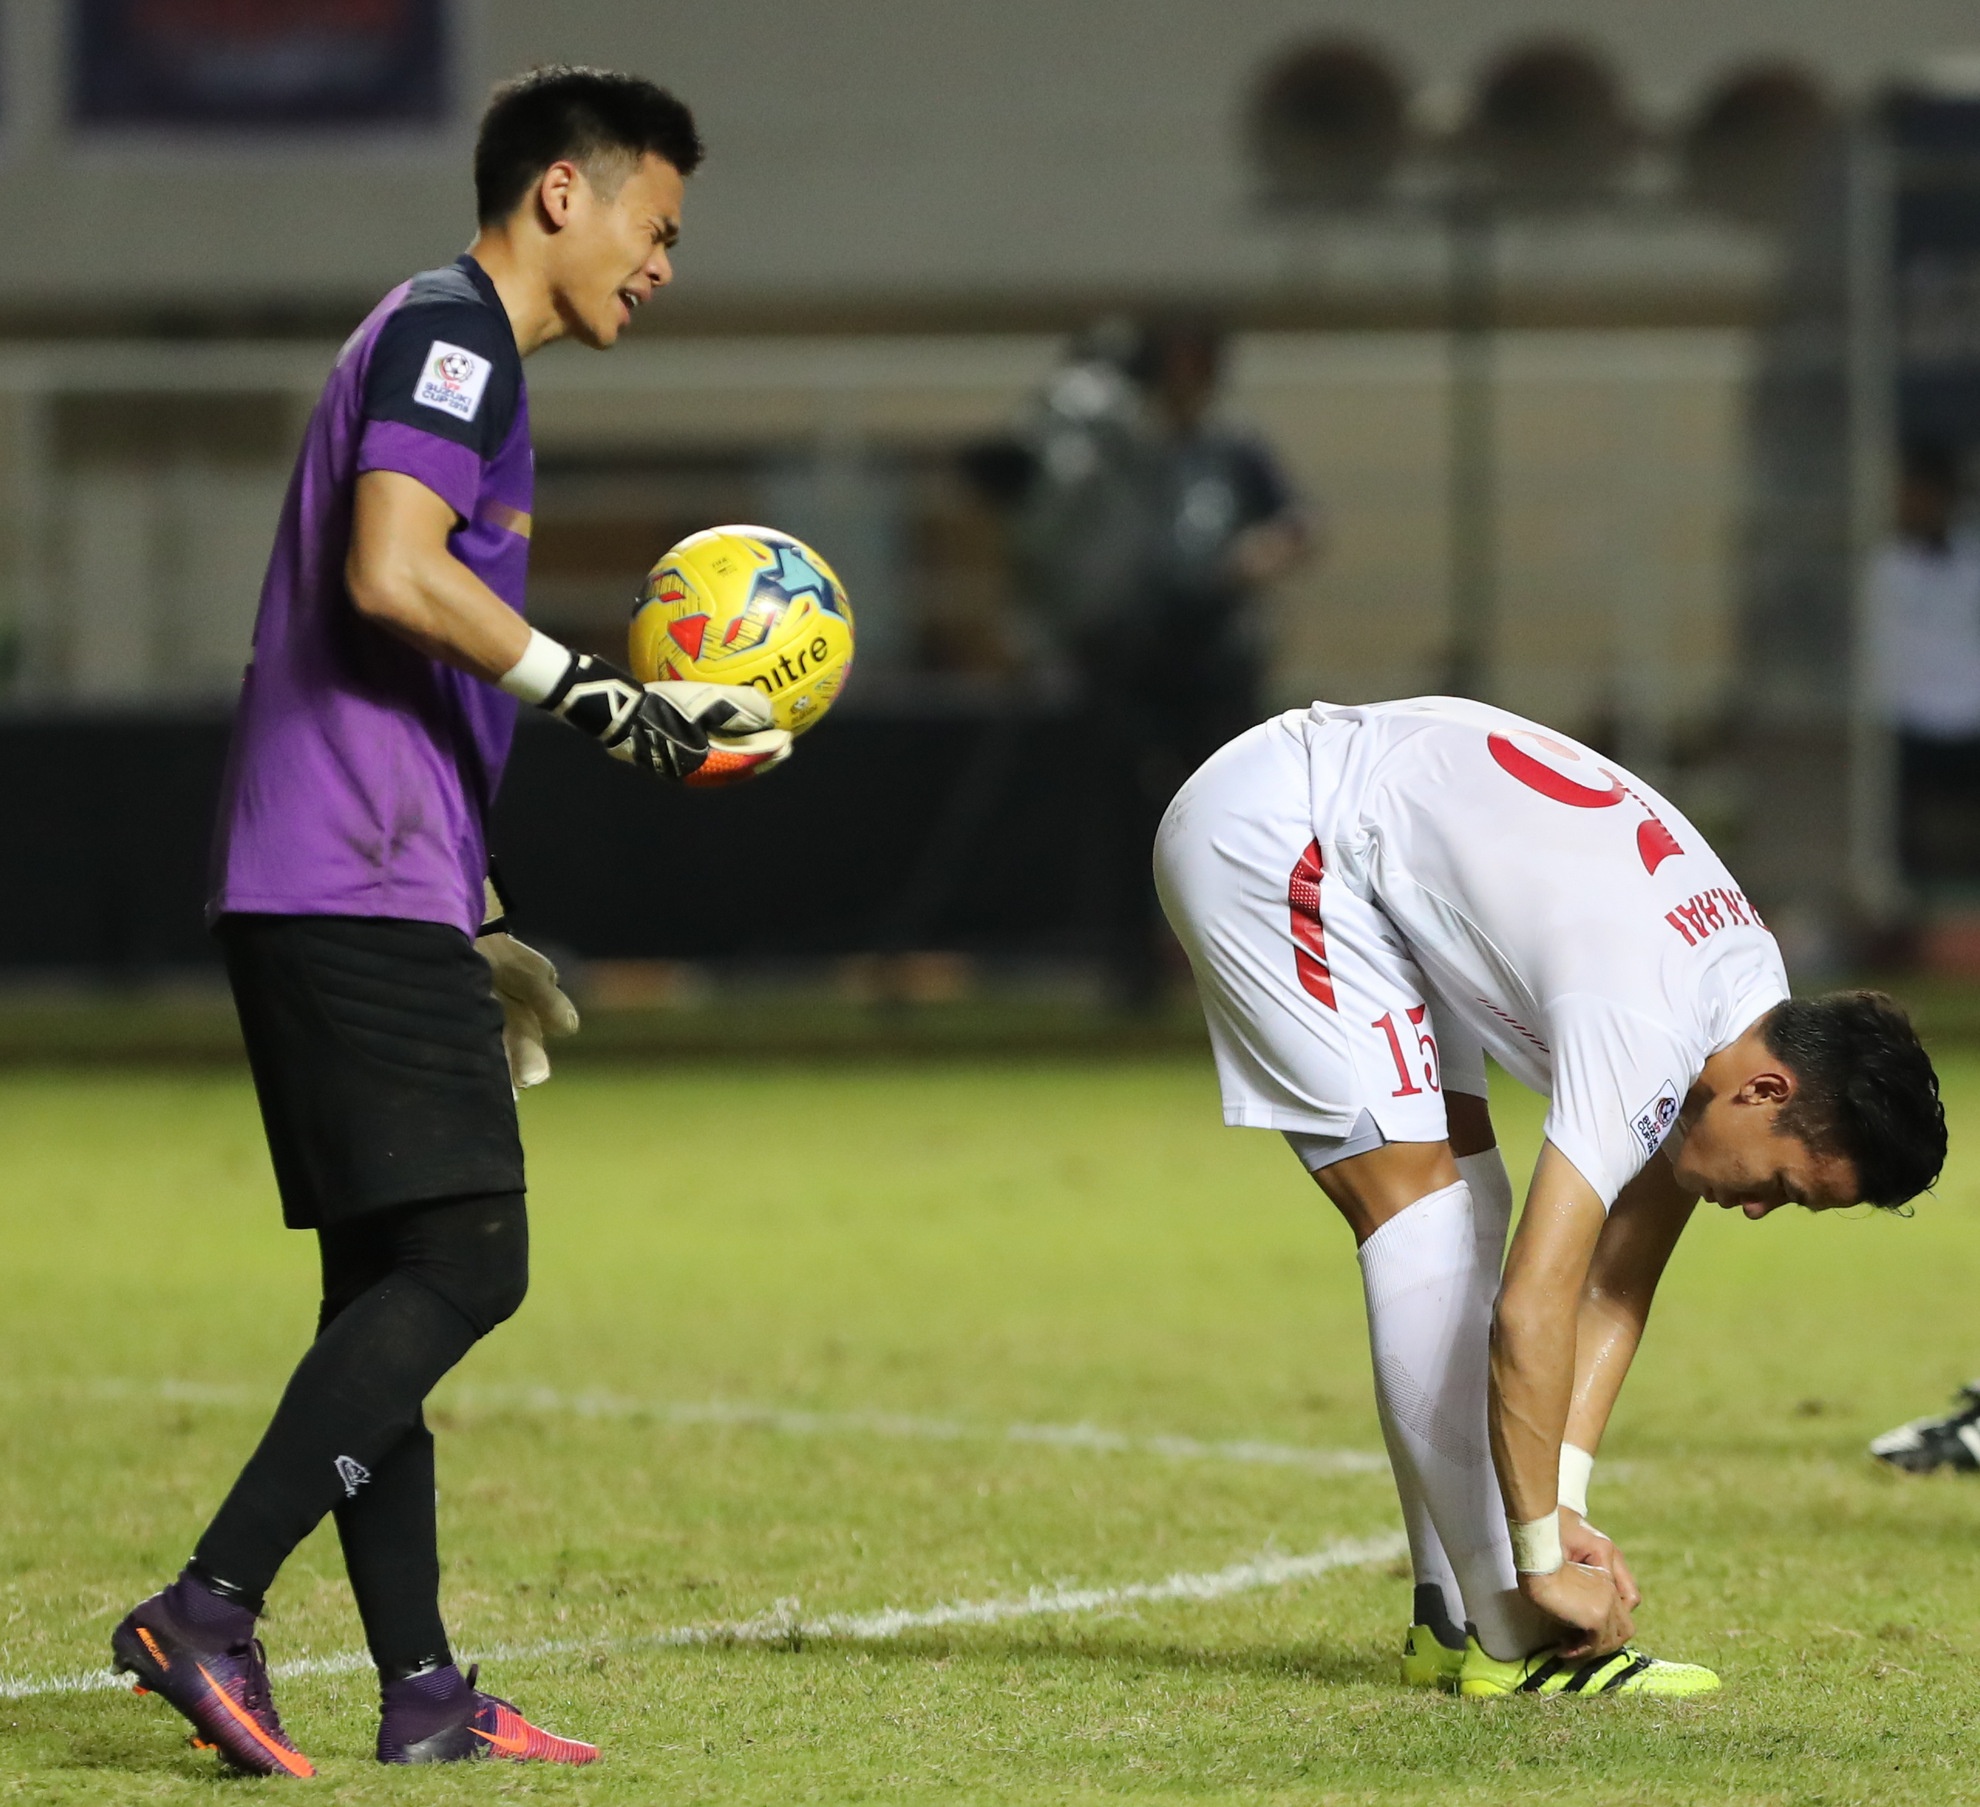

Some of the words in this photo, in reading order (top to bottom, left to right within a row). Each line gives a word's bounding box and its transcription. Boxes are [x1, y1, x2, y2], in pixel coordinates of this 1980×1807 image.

[422, 390, 448, 402] CUP
[1371, 1002, 1440, 1098] 15
[135, 1627, 171, 1671] MERCURIAL
